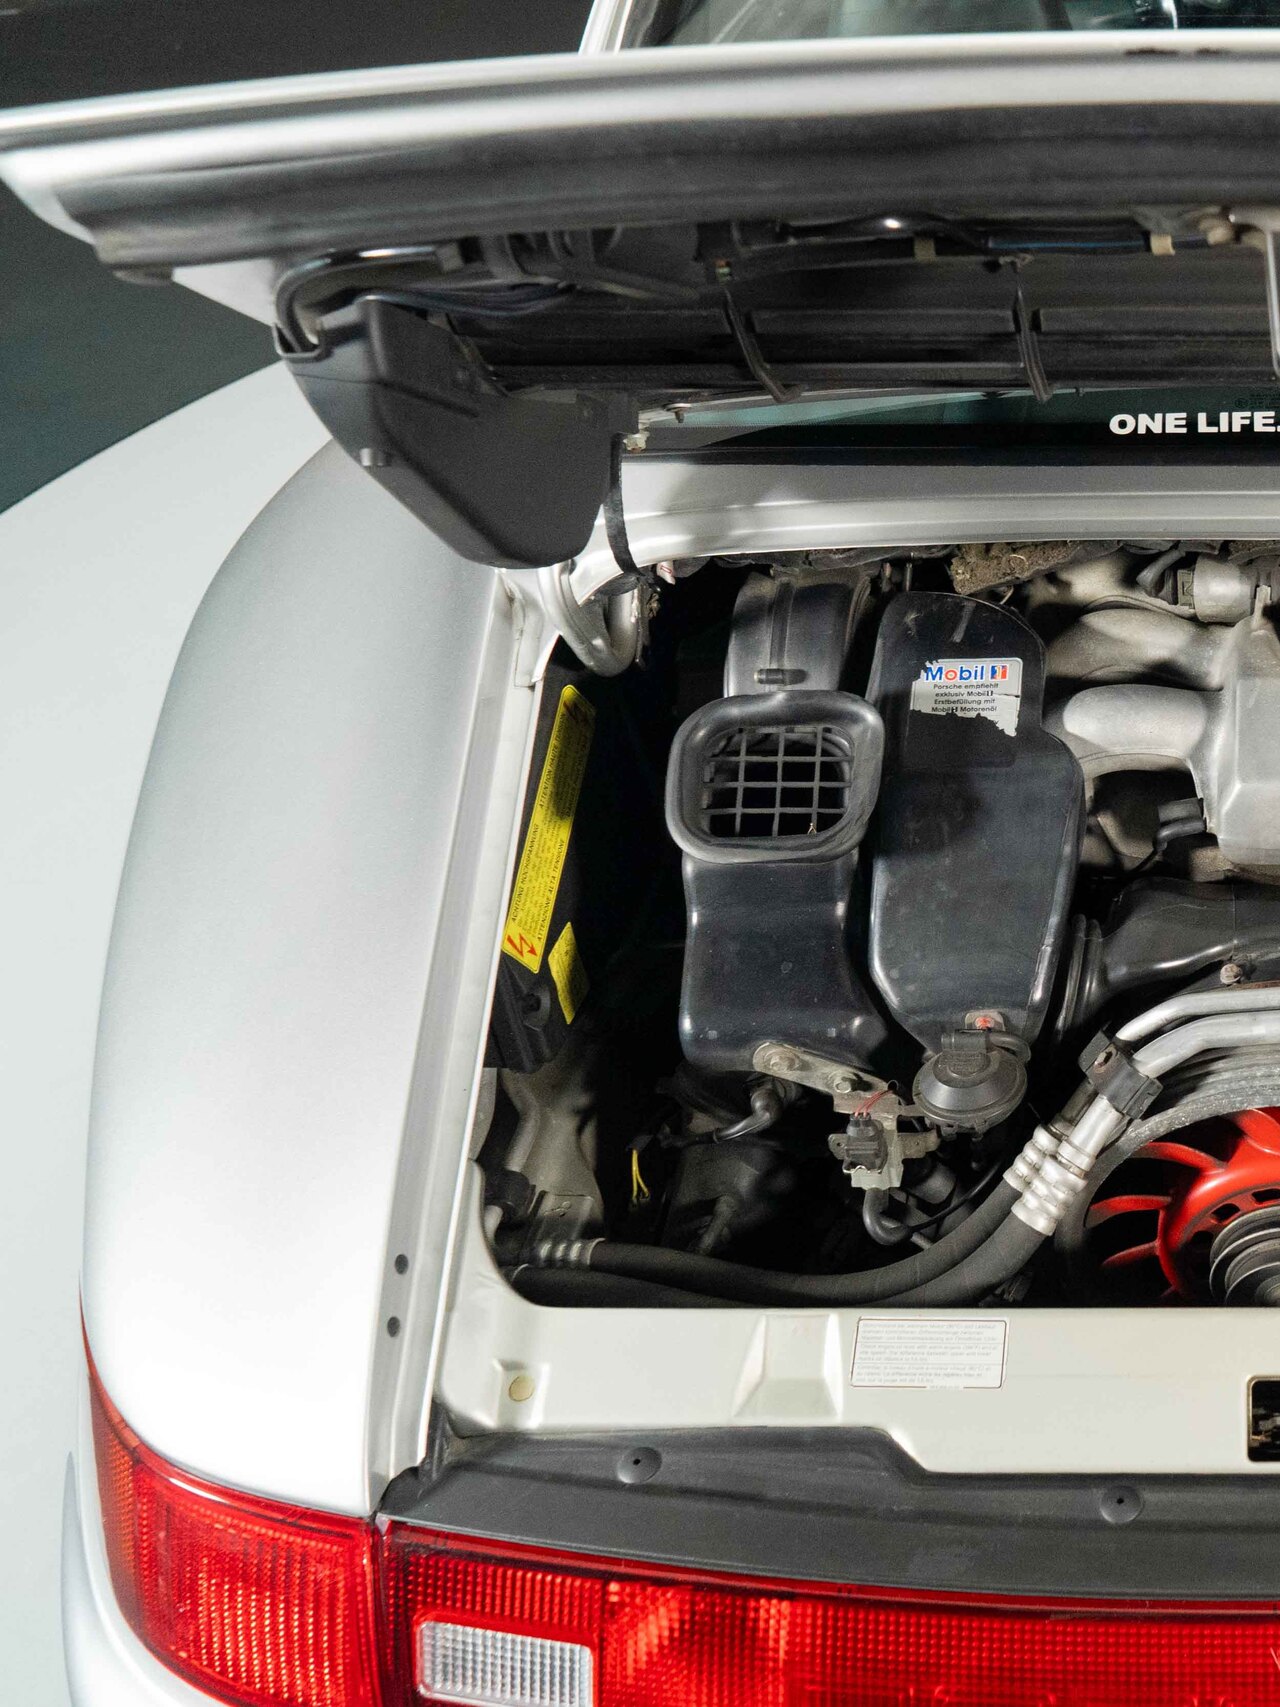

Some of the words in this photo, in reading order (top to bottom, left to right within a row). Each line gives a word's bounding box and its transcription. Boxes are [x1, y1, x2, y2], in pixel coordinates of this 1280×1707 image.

[1109, 412, 1187, 434] ONE
[925, 665, 985, 681] Mobil
[552, 840, 565, 873] TENSIONE
[511, 886, 524, 923] ACHTUNG
[520, 823, 539, 885] HOCHSPANNUNG
[548, 875, 557, 894] ALTA
[537, 897, 552, 941] ATTENZIONE
